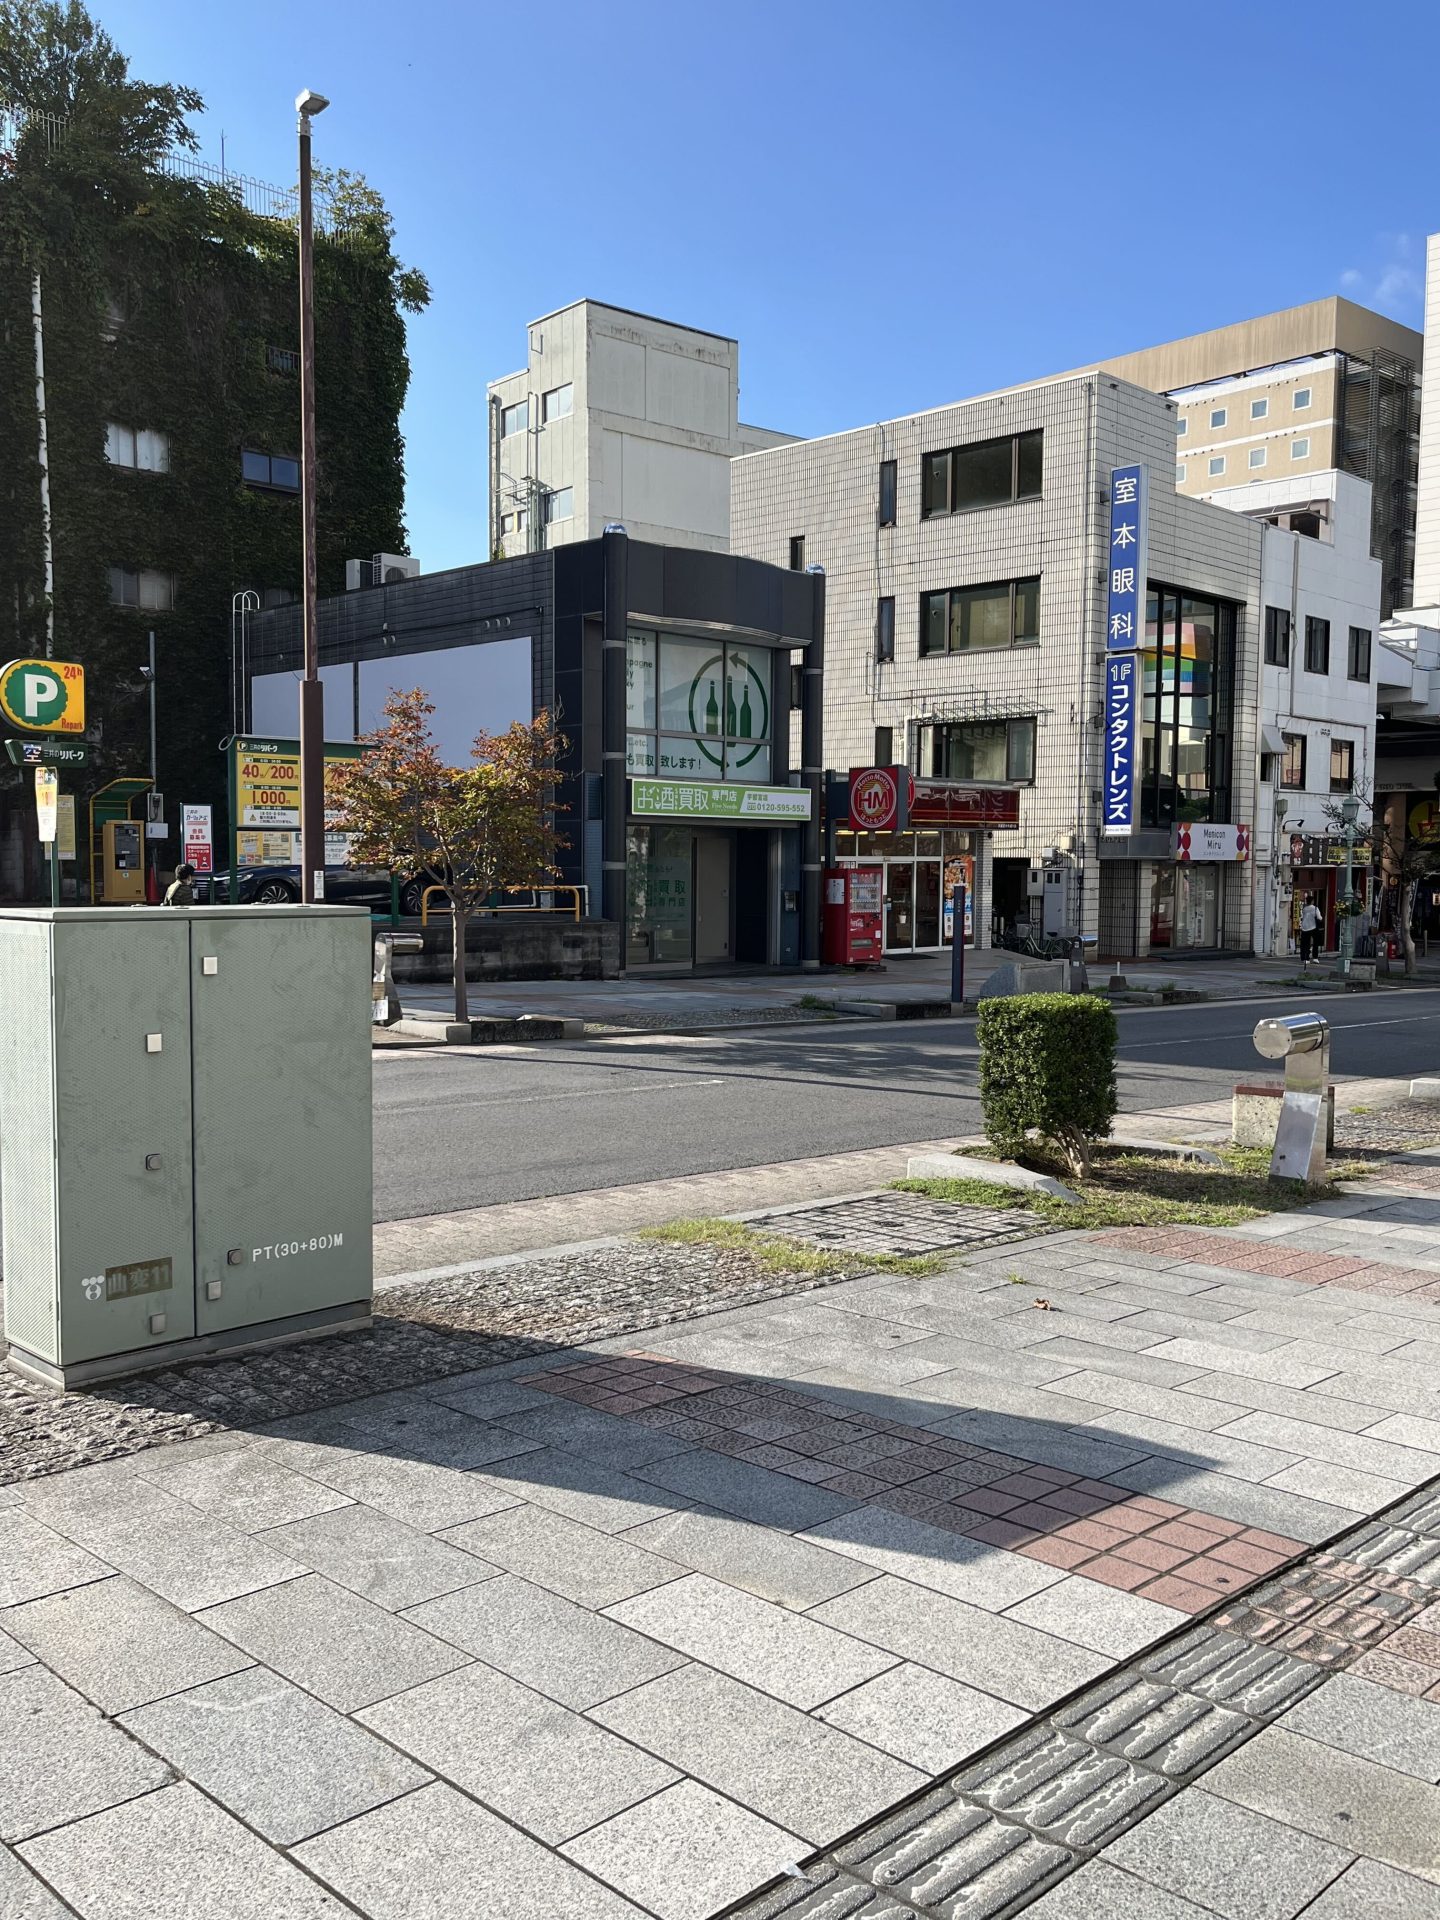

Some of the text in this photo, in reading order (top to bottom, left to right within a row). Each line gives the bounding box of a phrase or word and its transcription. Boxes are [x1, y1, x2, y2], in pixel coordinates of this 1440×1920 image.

[1110, 477, 1137, 639] 室本眼科
[627, 659, 653, 669] pagne
[1111, 663, 1131, 681] 1F
[24, 673, 58, 717] P
[61, 718, 83, 730] Repark
[23, 744, 42, 762] 空
[1108, 684, 1129, 820] コンタクトレンズ
[756, 803, 805, 812] 0120-595-552
[858, 790, 890, 810] HM
[1203, 828, 1226, 838] Menicon
[1207, 840, 1221, 849] Miru
[252, 1233, 343, 1262] PT(30+80)M
